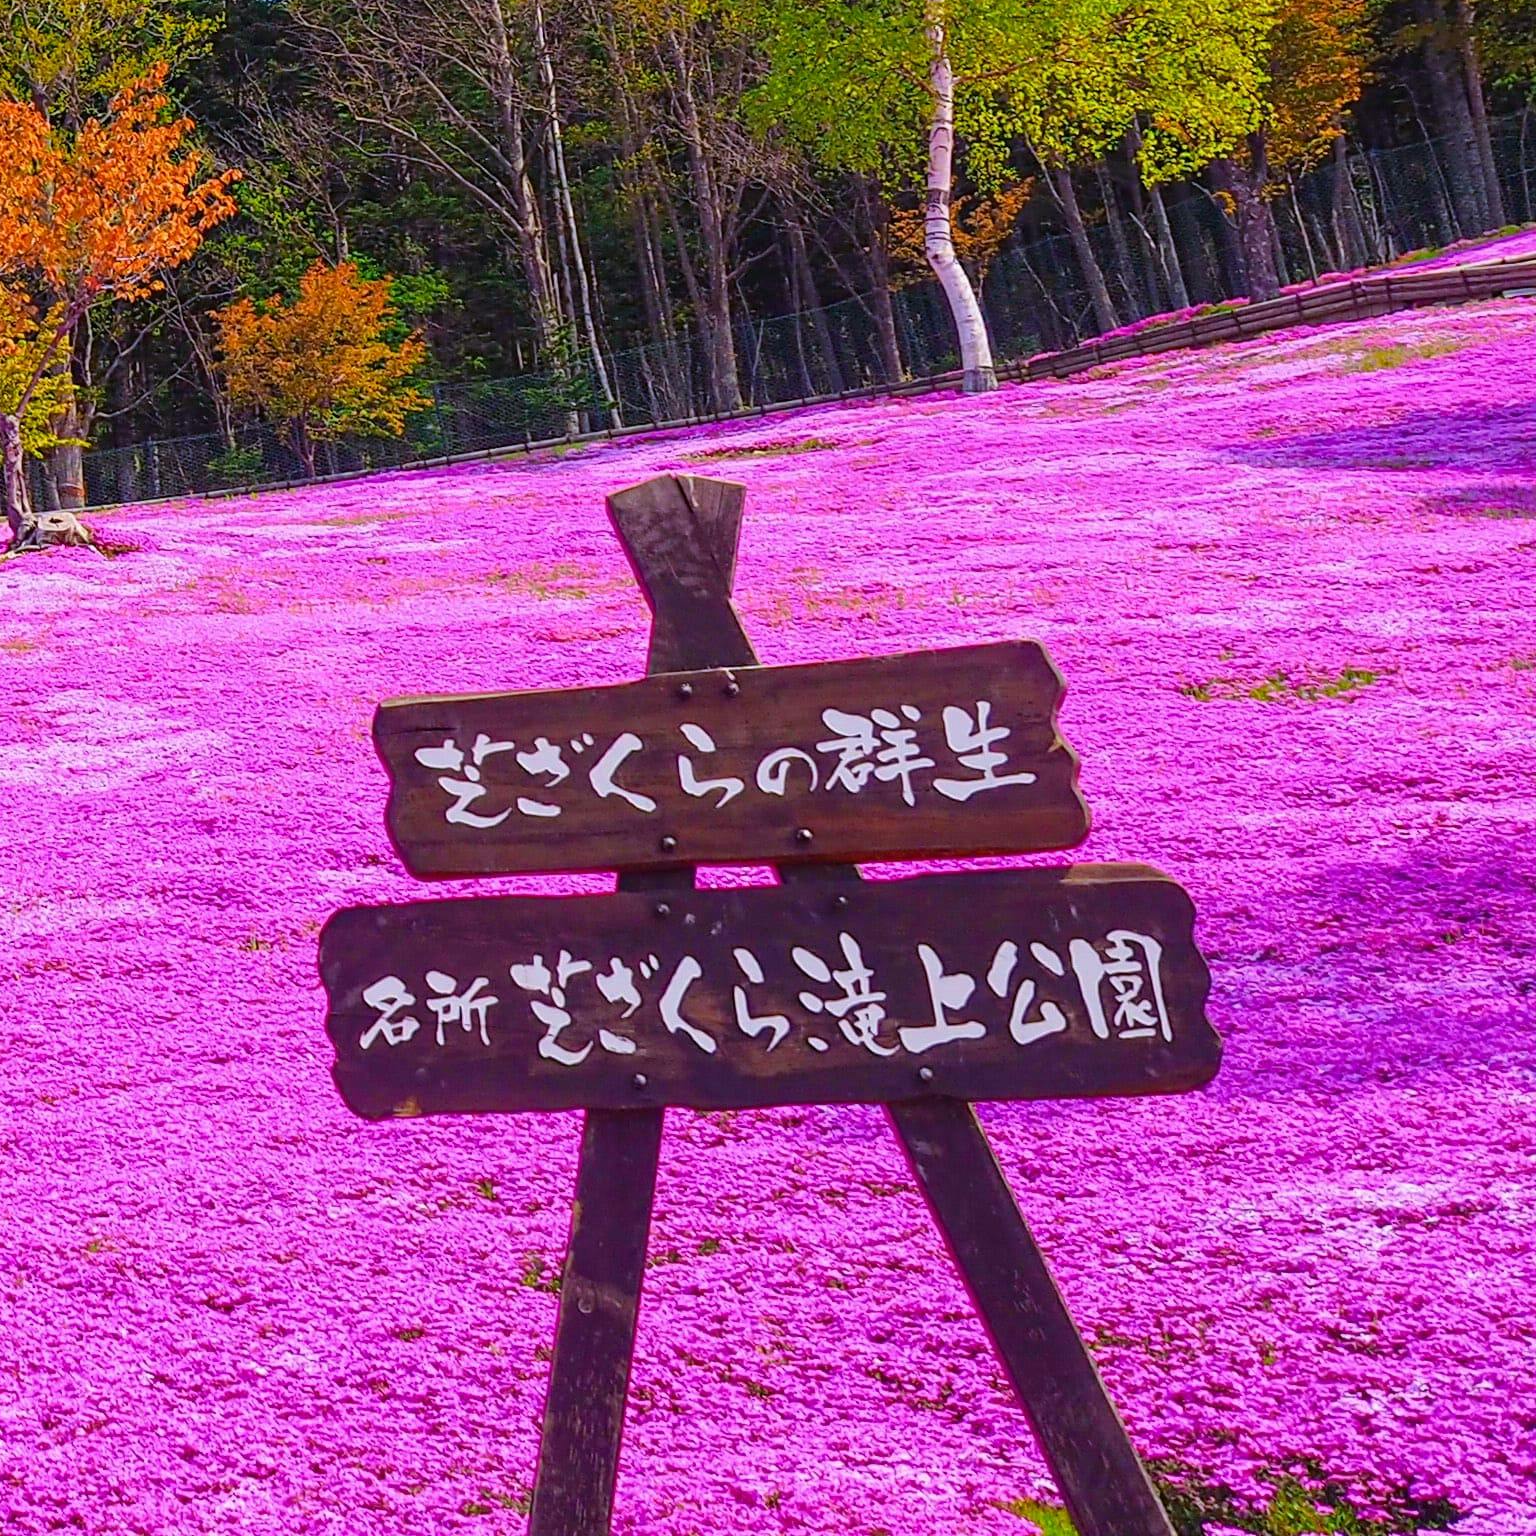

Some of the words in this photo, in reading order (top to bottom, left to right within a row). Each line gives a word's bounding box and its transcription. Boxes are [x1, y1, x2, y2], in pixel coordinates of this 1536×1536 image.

[414, 700, 1036, 828] 芝ざくらの群生
[359, 970, 500, 1049] 名所
